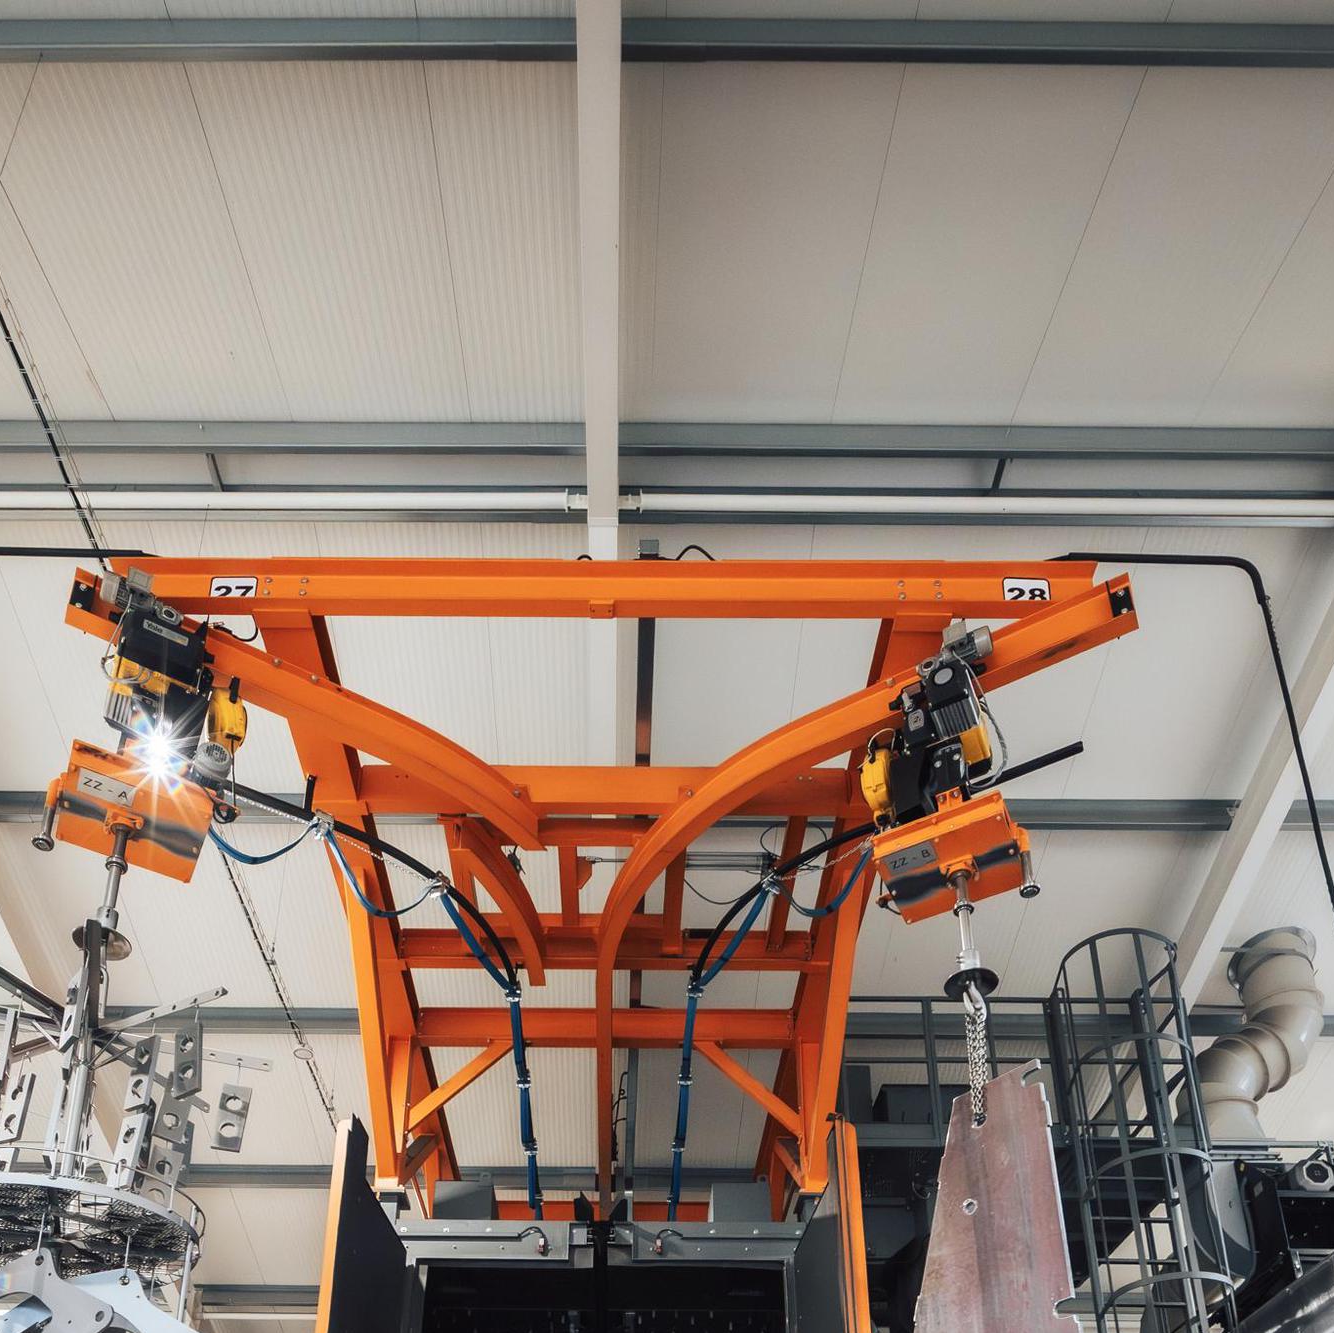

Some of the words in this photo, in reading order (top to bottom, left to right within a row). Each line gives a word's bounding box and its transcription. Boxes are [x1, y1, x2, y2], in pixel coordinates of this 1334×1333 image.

[214, 585, 254, 597] 27
[1007, 587, 1047, 600] 28
[83, 776, 103, 792] ZZ
[117, 790, 128, 801] A
[889, 856, 909, 870] ZZ
[921, 849, 931, 858] B
